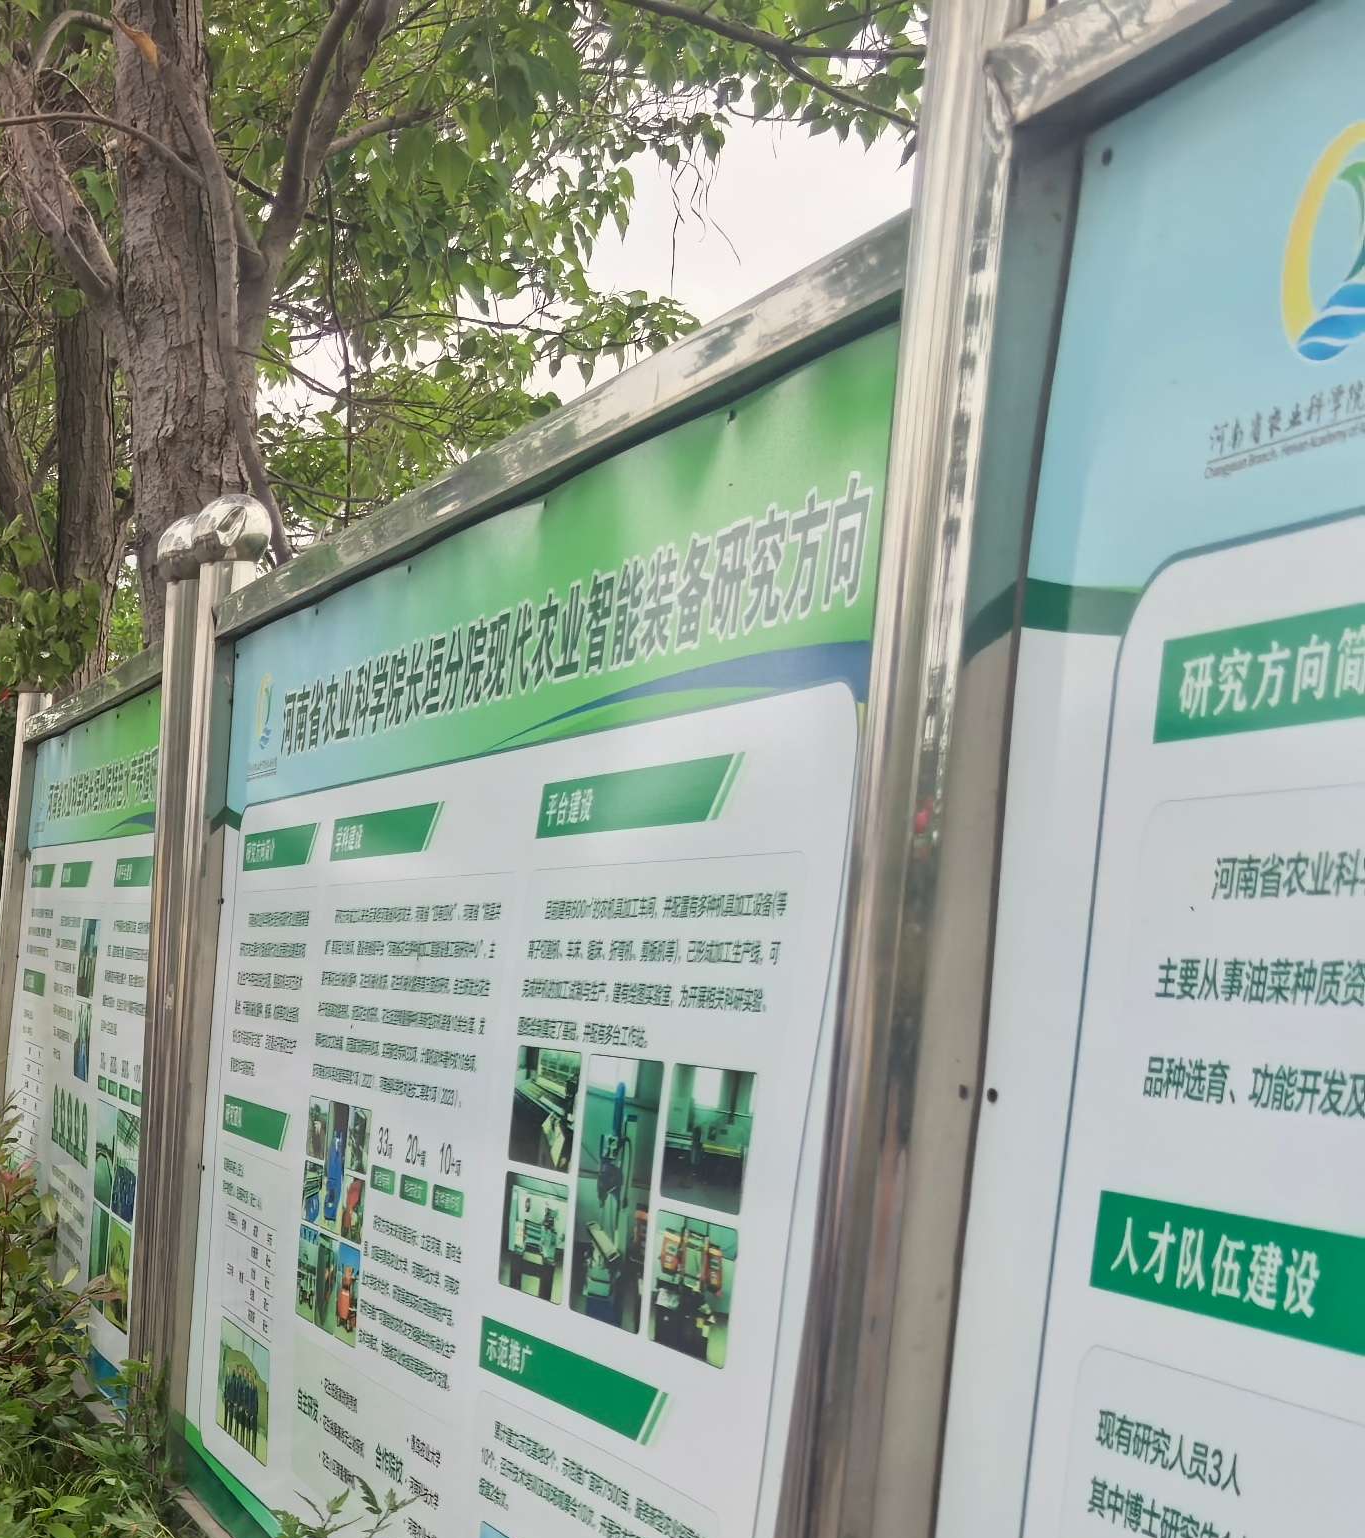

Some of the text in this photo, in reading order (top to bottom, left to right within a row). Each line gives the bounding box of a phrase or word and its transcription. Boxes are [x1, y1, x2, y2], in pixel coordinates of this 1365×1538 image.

[279, 472, 873, 757] 河南省农业科学院长垣分院现代农业智能装备研究方向
[1178, 624, 1365, 720] 研究方向简
[545, 787, 595, 828] 平台建设
[1154, 957, 1365, 1007] 主要从事油菜种质资
[1142, 1055, 1365, 1119] 品种选育、功能开发及
[1110, 1216, 1320, 1318] 人才队伍建设
[485, 1331, 533, 1375] 示范推广
[1095, 1409, 1242, 1497] 现有研究人员3人
